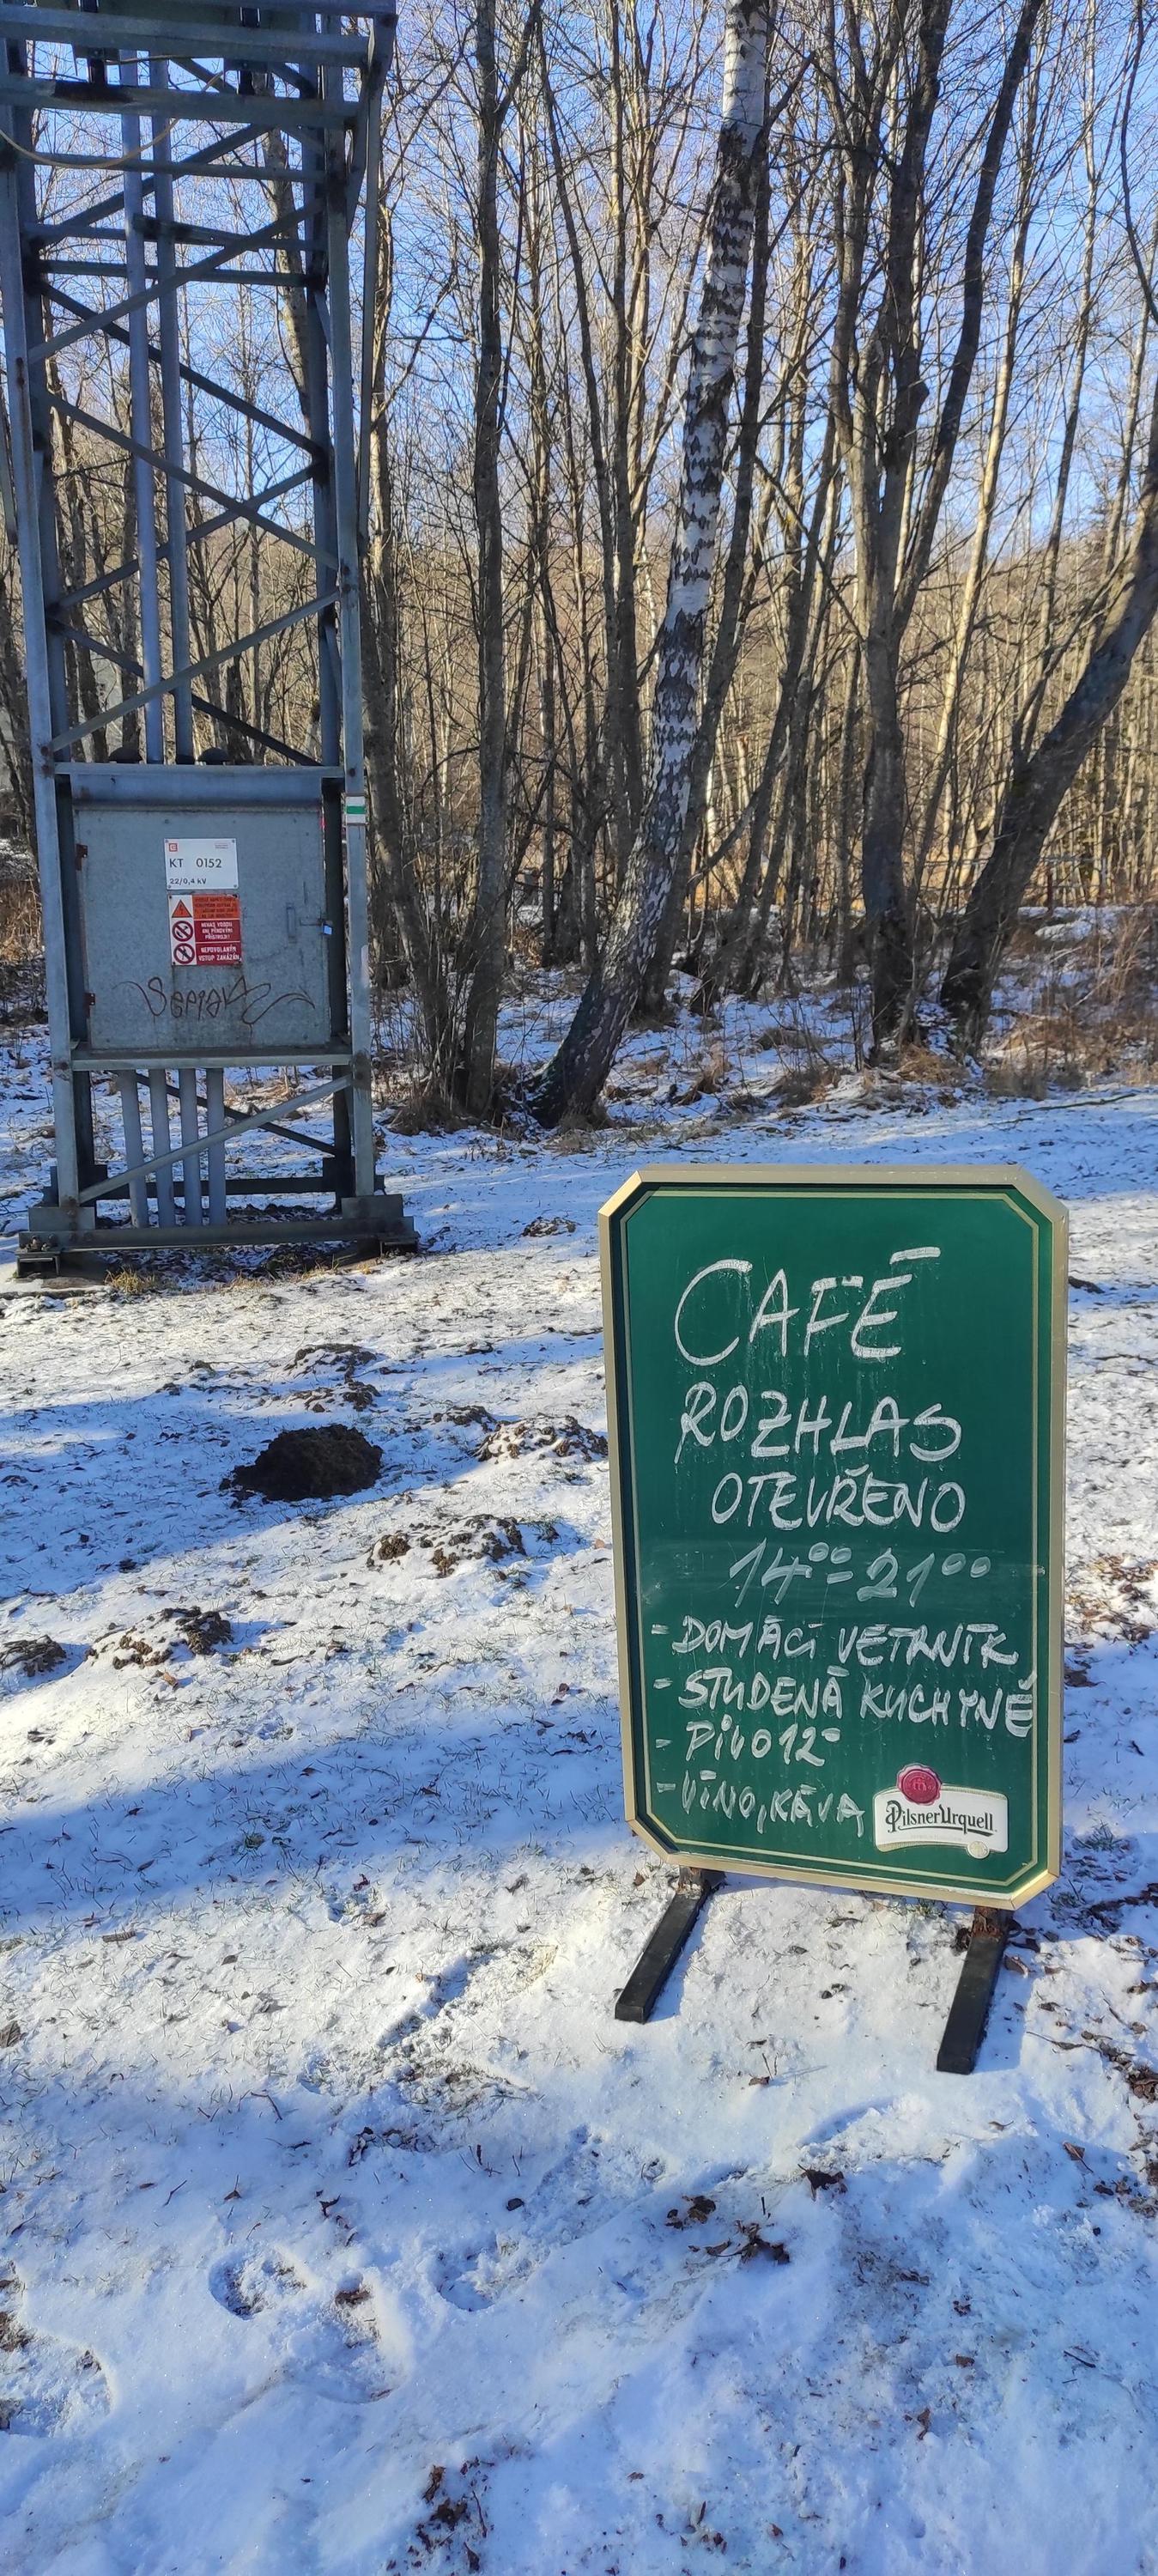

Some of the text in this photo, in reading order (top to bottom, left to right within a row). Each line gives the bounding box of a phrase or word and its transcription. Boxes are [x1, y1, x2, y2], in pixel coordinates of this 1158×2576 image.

[169, 858, 222, 868] KT 0152
[675, 1246, 941, 1366] CAFÉ
[675, 1381, 962, 1464] ROZHLAS
[712, 1463, 967, 1533] OTEVŘENO
[885, 1800, 994, 1835] Pilsner Urquell
